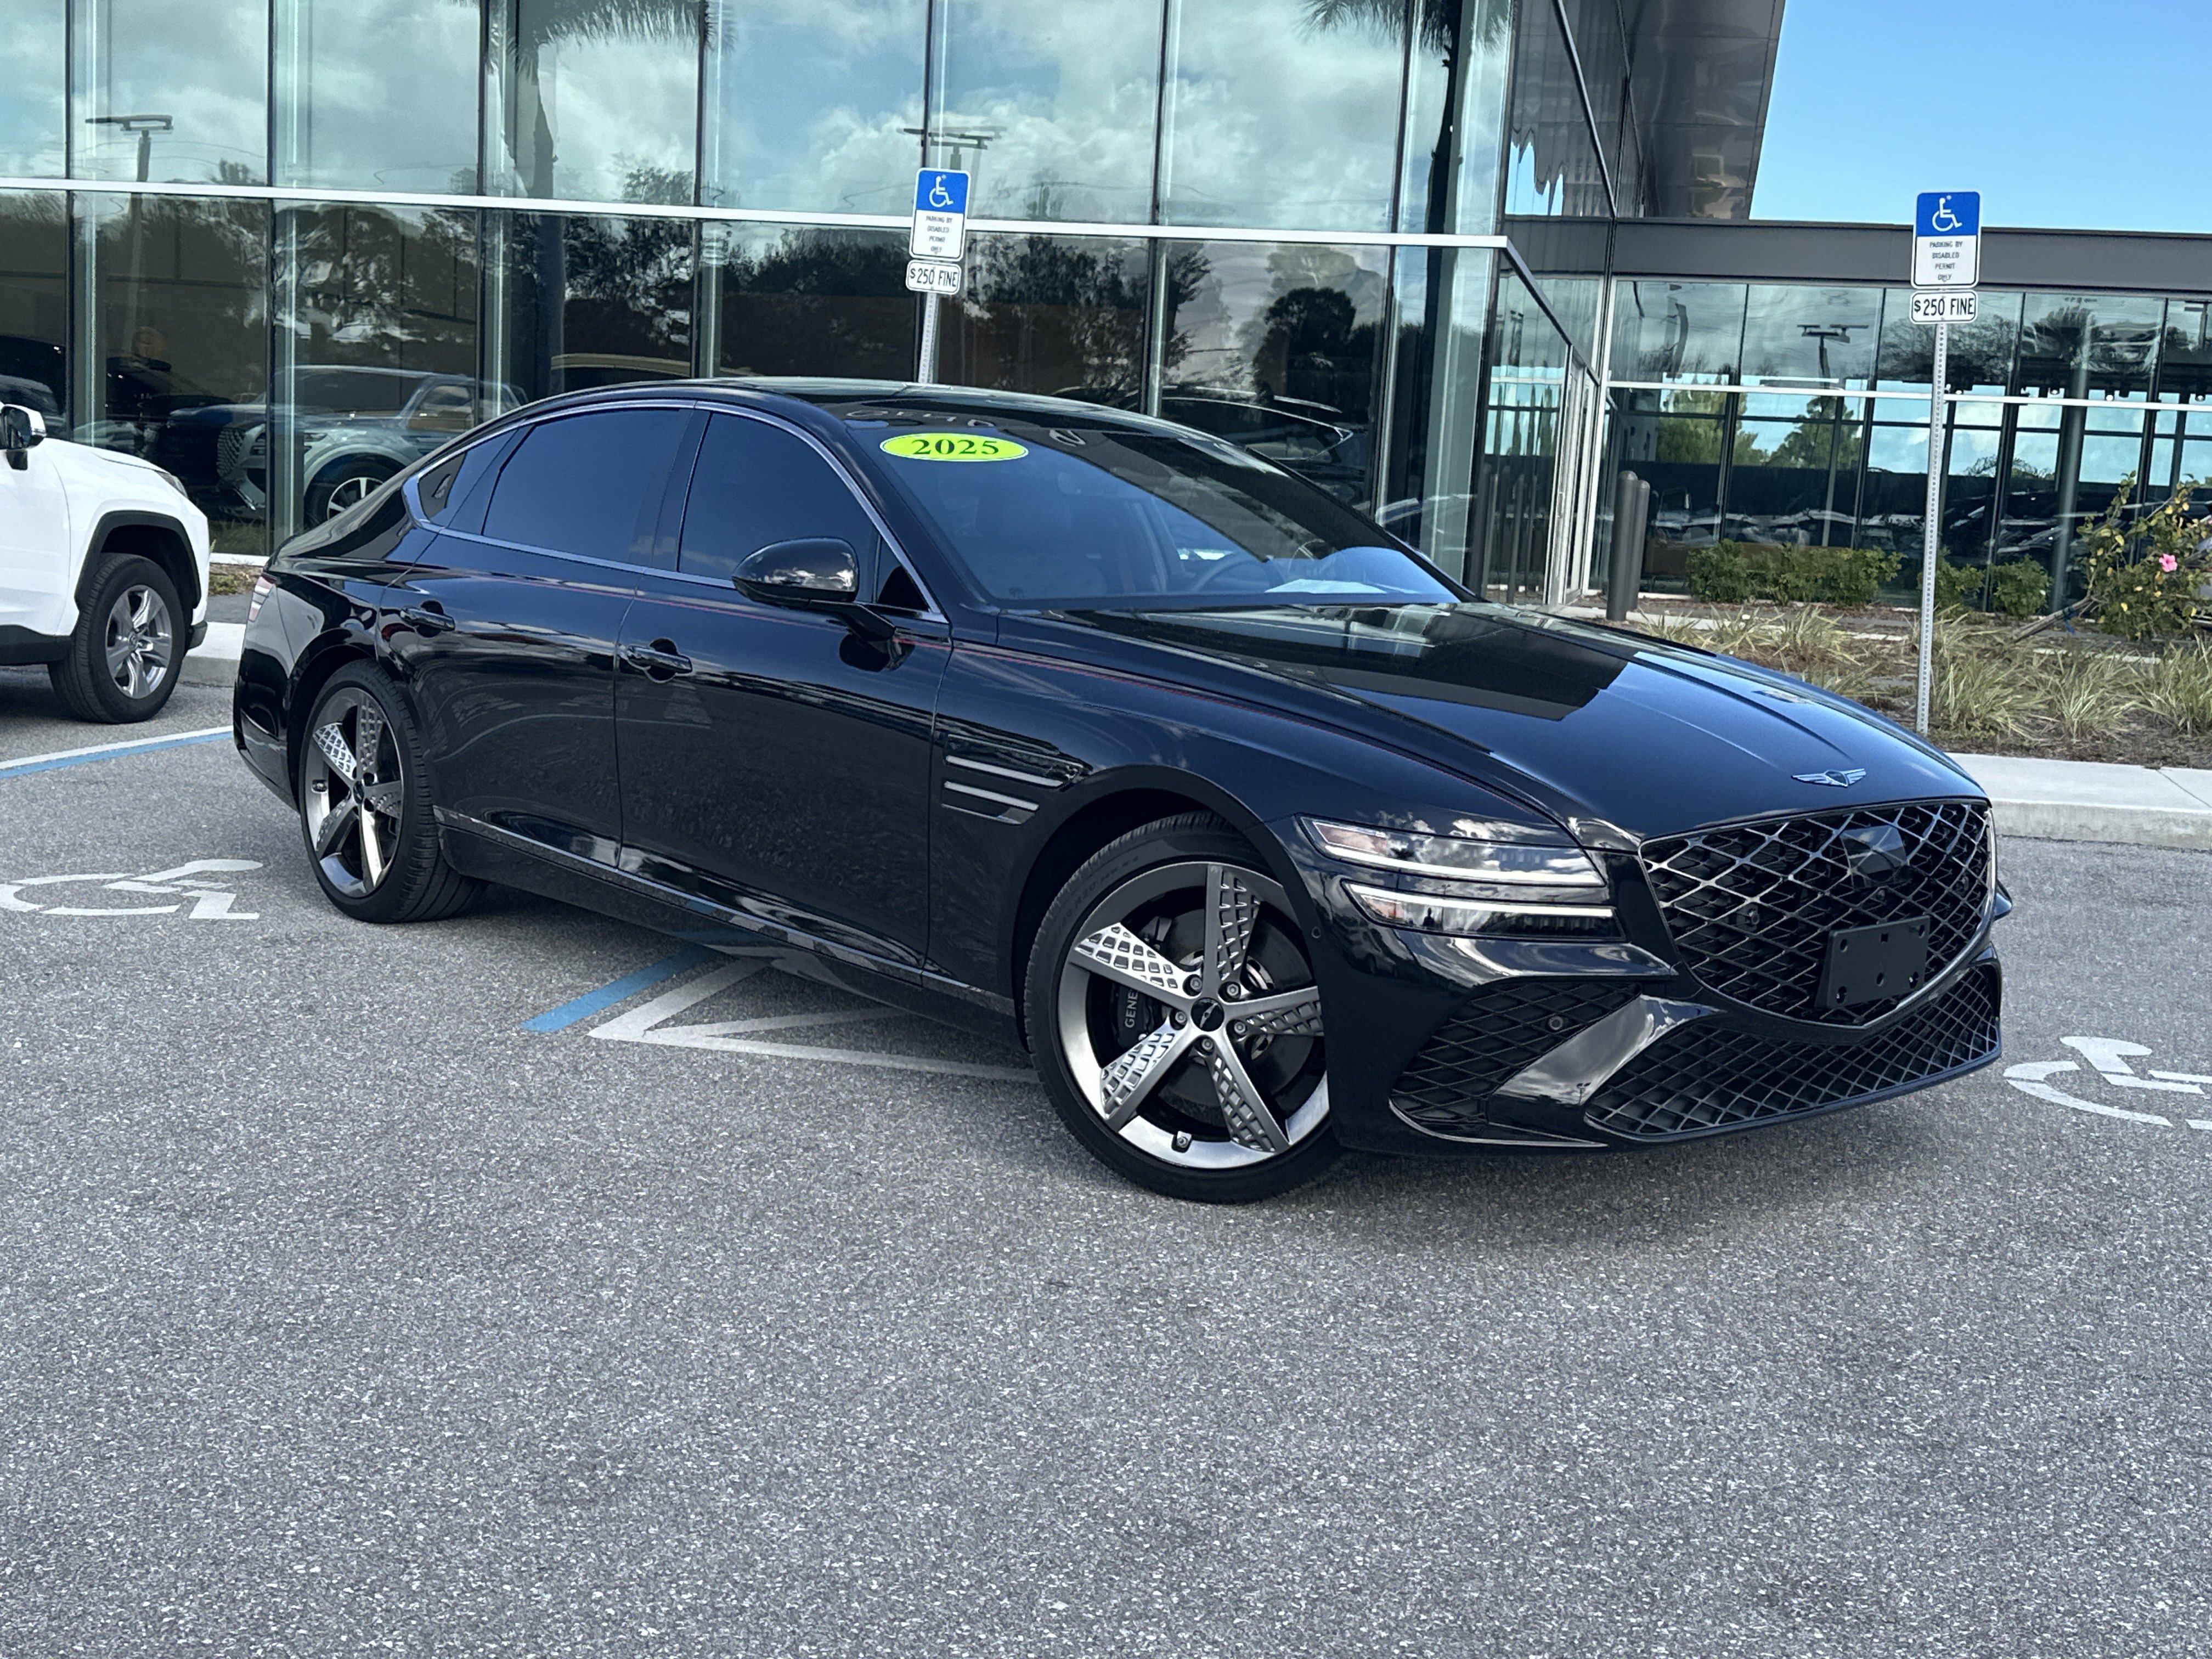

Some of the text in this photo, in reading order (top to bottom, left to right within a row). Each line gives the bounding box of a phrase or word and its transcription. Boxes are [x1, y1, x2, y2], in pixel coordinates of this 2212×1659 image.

[910, 268, 958, 287] $250 FINE
[1914, 297, 1974, 316] $250 FINE
[911, 438, 999, 455] 2025
[1125, 991, 1138, 1028] GENE
